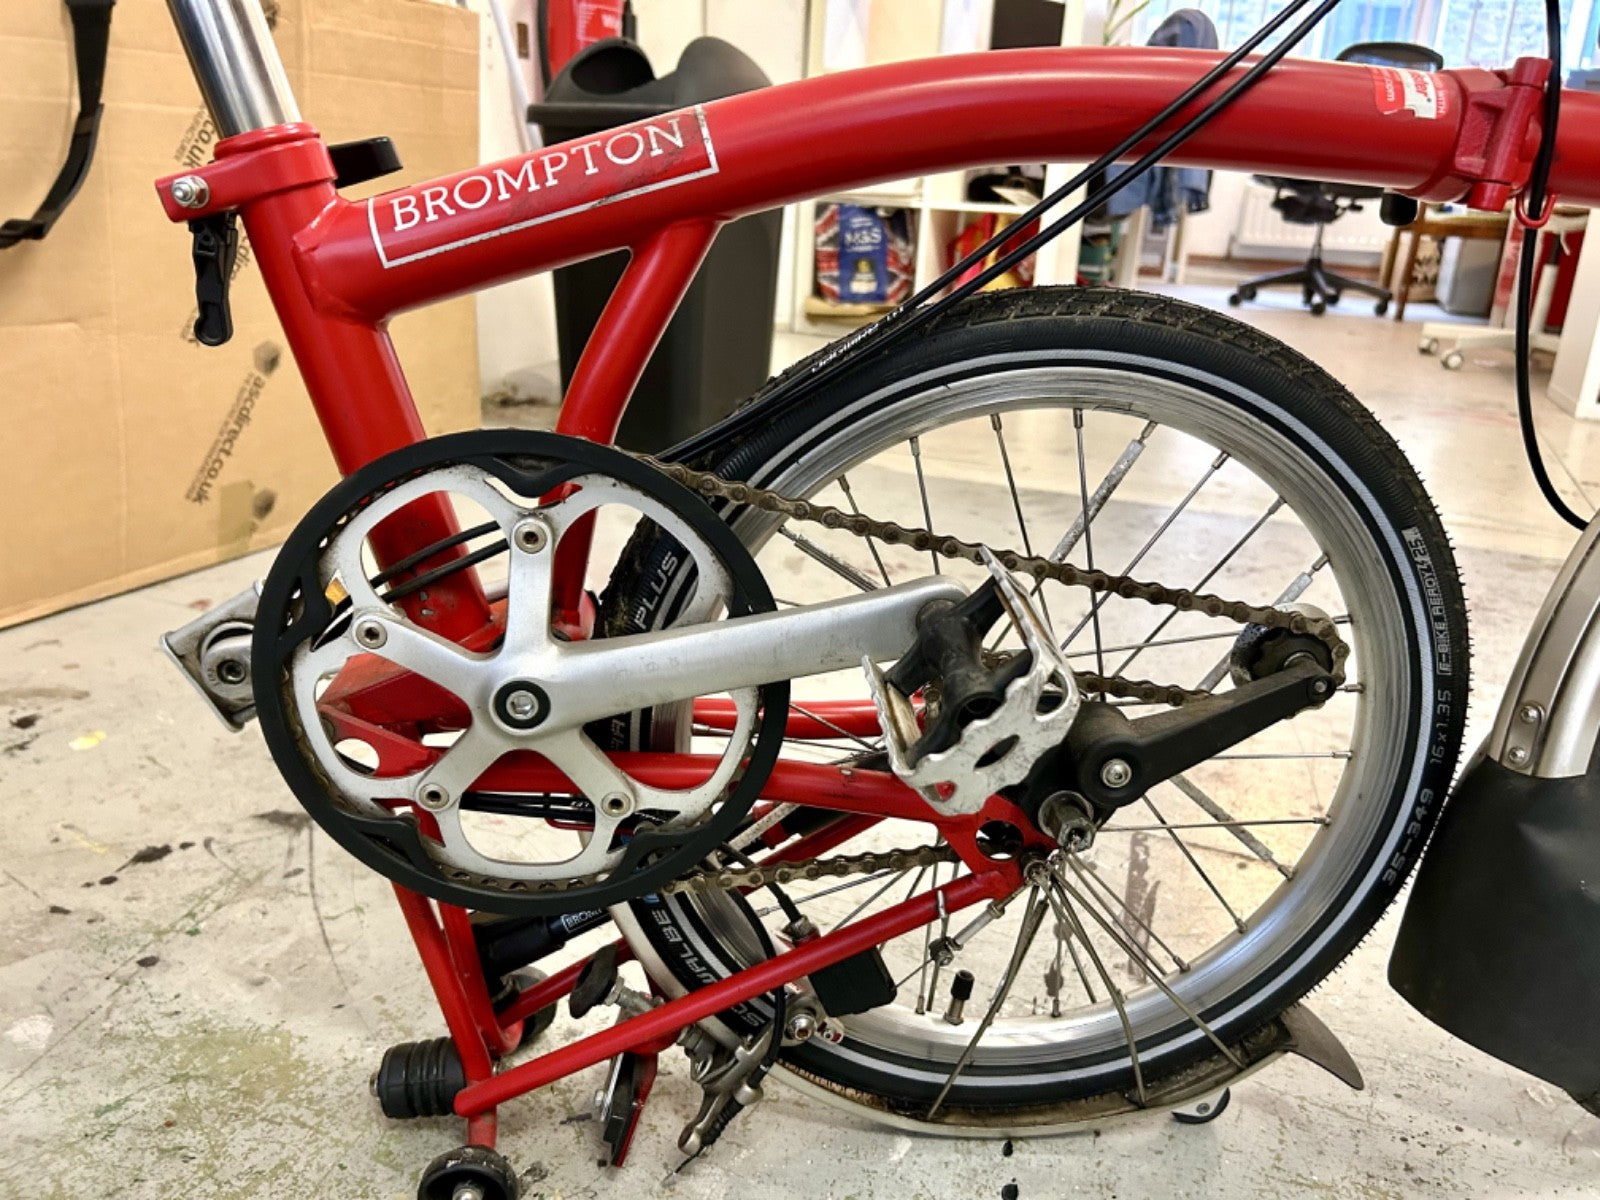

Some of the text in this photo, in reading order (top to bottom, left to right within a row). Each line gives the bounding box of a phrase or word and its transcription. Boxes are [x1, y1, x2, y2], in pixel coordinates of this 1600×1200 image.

[389, 117, 685, 232] BROMPTON
[191, 376, 266, 505] ascdirect.co.uk
[632, 550, 680, 630] PLUS
[1430, 690, 1452, 764] 16x1.35
